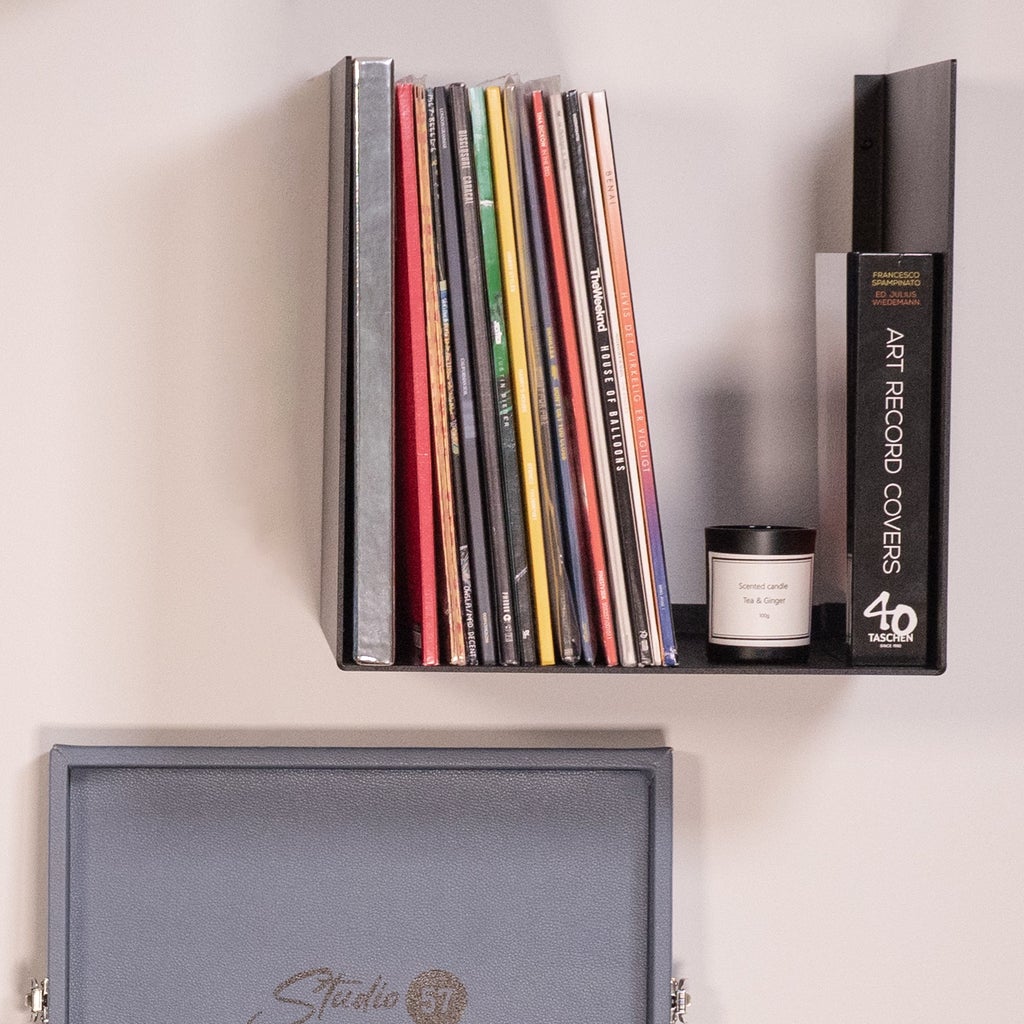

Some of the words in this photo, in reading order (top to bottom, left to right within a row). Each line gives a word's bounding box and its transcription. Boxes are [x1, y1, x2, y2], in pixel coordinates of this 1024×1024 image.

[458, 129, 470, 168] DISCLOSURE
[462, 175, 474, 204] CARACAL
[871, 279, 921, 287] SPAMPINATO
[873, 271, 921, 279] FRANCESCO
[589, 267, 607, 332] TheWeeknd
[619, 291, 631, 318] HVIS
[624, 323, 634, 346] DET
[885, 327, 904, 373] ART
[599, 344, 613, 383] HOUSE
[626, 350, 640, 403] VIRKELIG
[606, 389, 616, 404] OF
[635, 408, 644, 422] ER
[883, 381, 903, 474] RECORD
[608, 409, 626, 472] BALLOONS
[636, 427, 650, 473] VIGTIGT
[882, 483, 902, 574] COVERS
[738, 582, 765, 590] Scented
[767, 582, 789, 590] candle
[763, 597, 786, 606] Ginger
[863, 591, 918, 637] 40
[868, 633, 914, 643] TASCHEN
